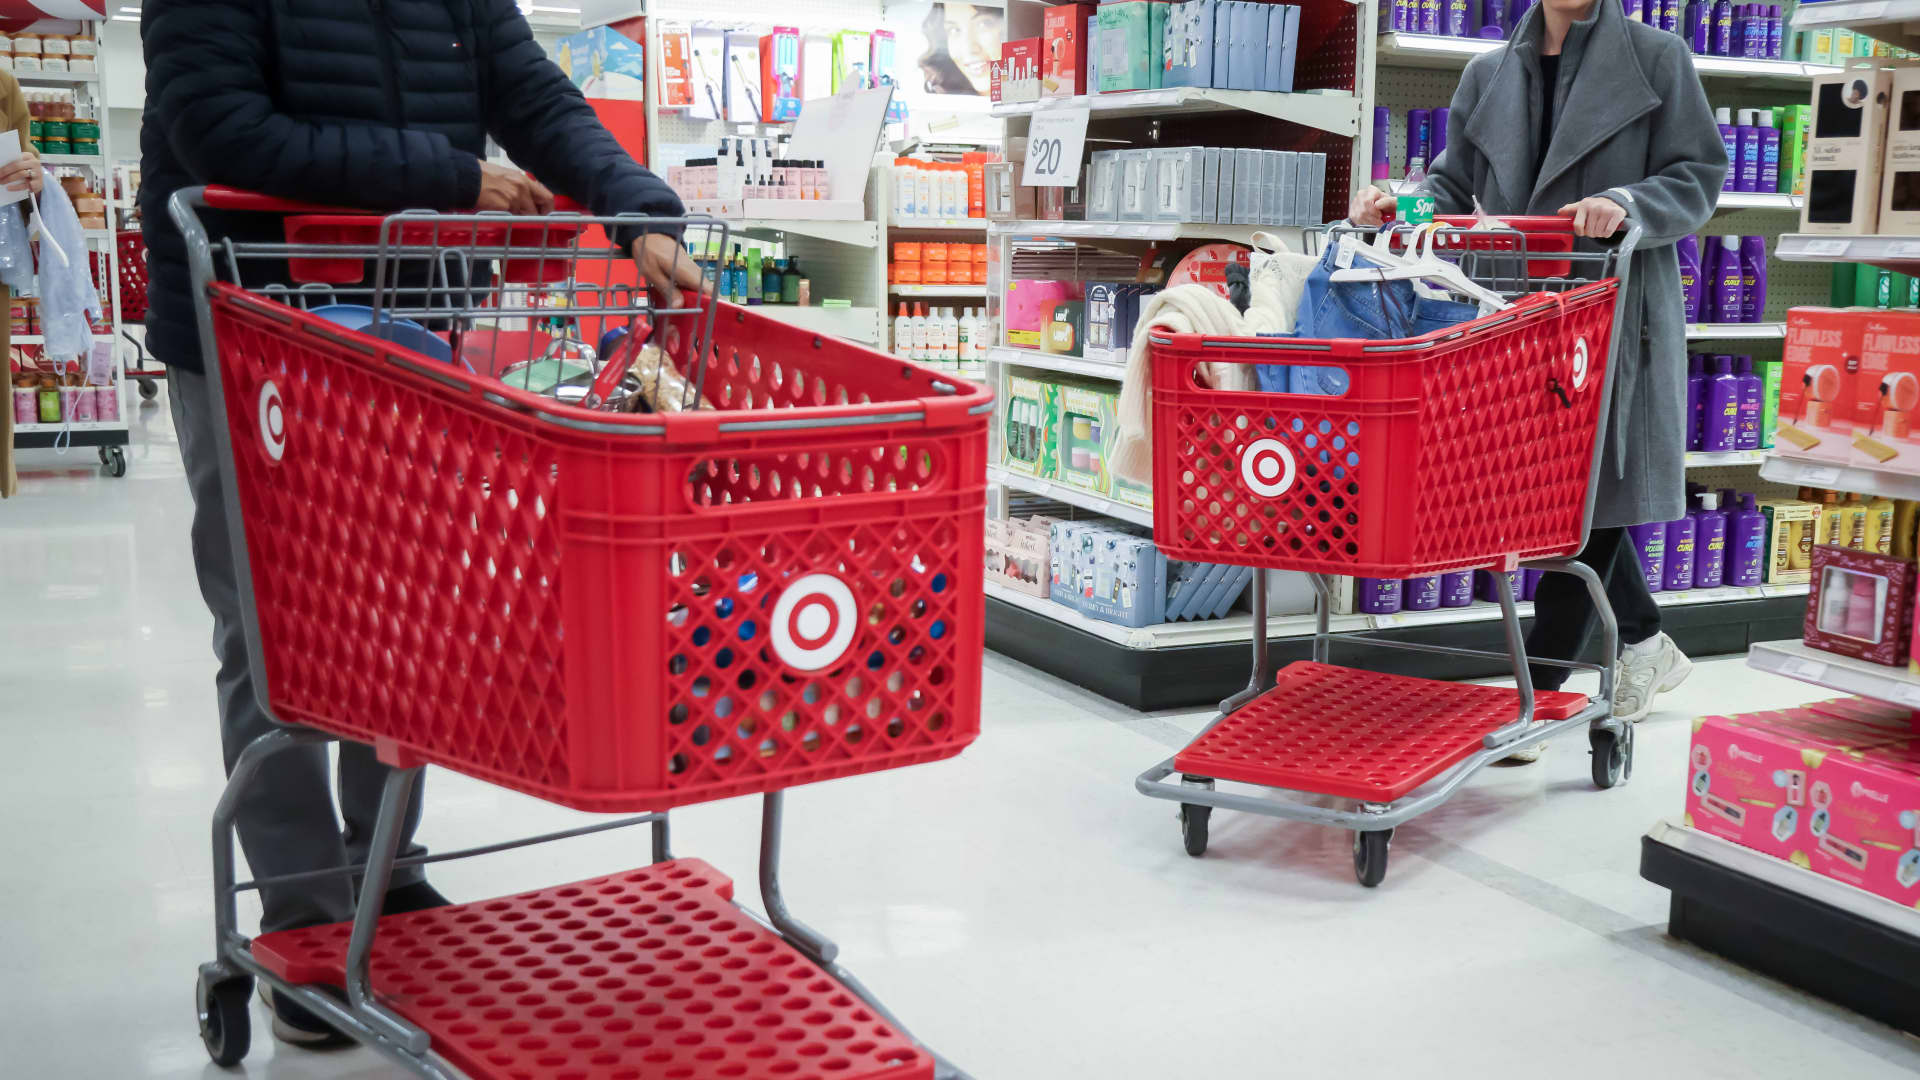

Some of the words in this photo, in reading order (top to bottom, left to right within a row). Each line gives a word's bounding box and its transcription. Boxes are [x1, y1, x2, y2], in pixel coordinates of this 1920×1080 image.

[1032, 138, 1062, 175] $20
[1413, 199, 1434, 216] Spr
[1787, 327, 1842, 348] FLAWLESS
